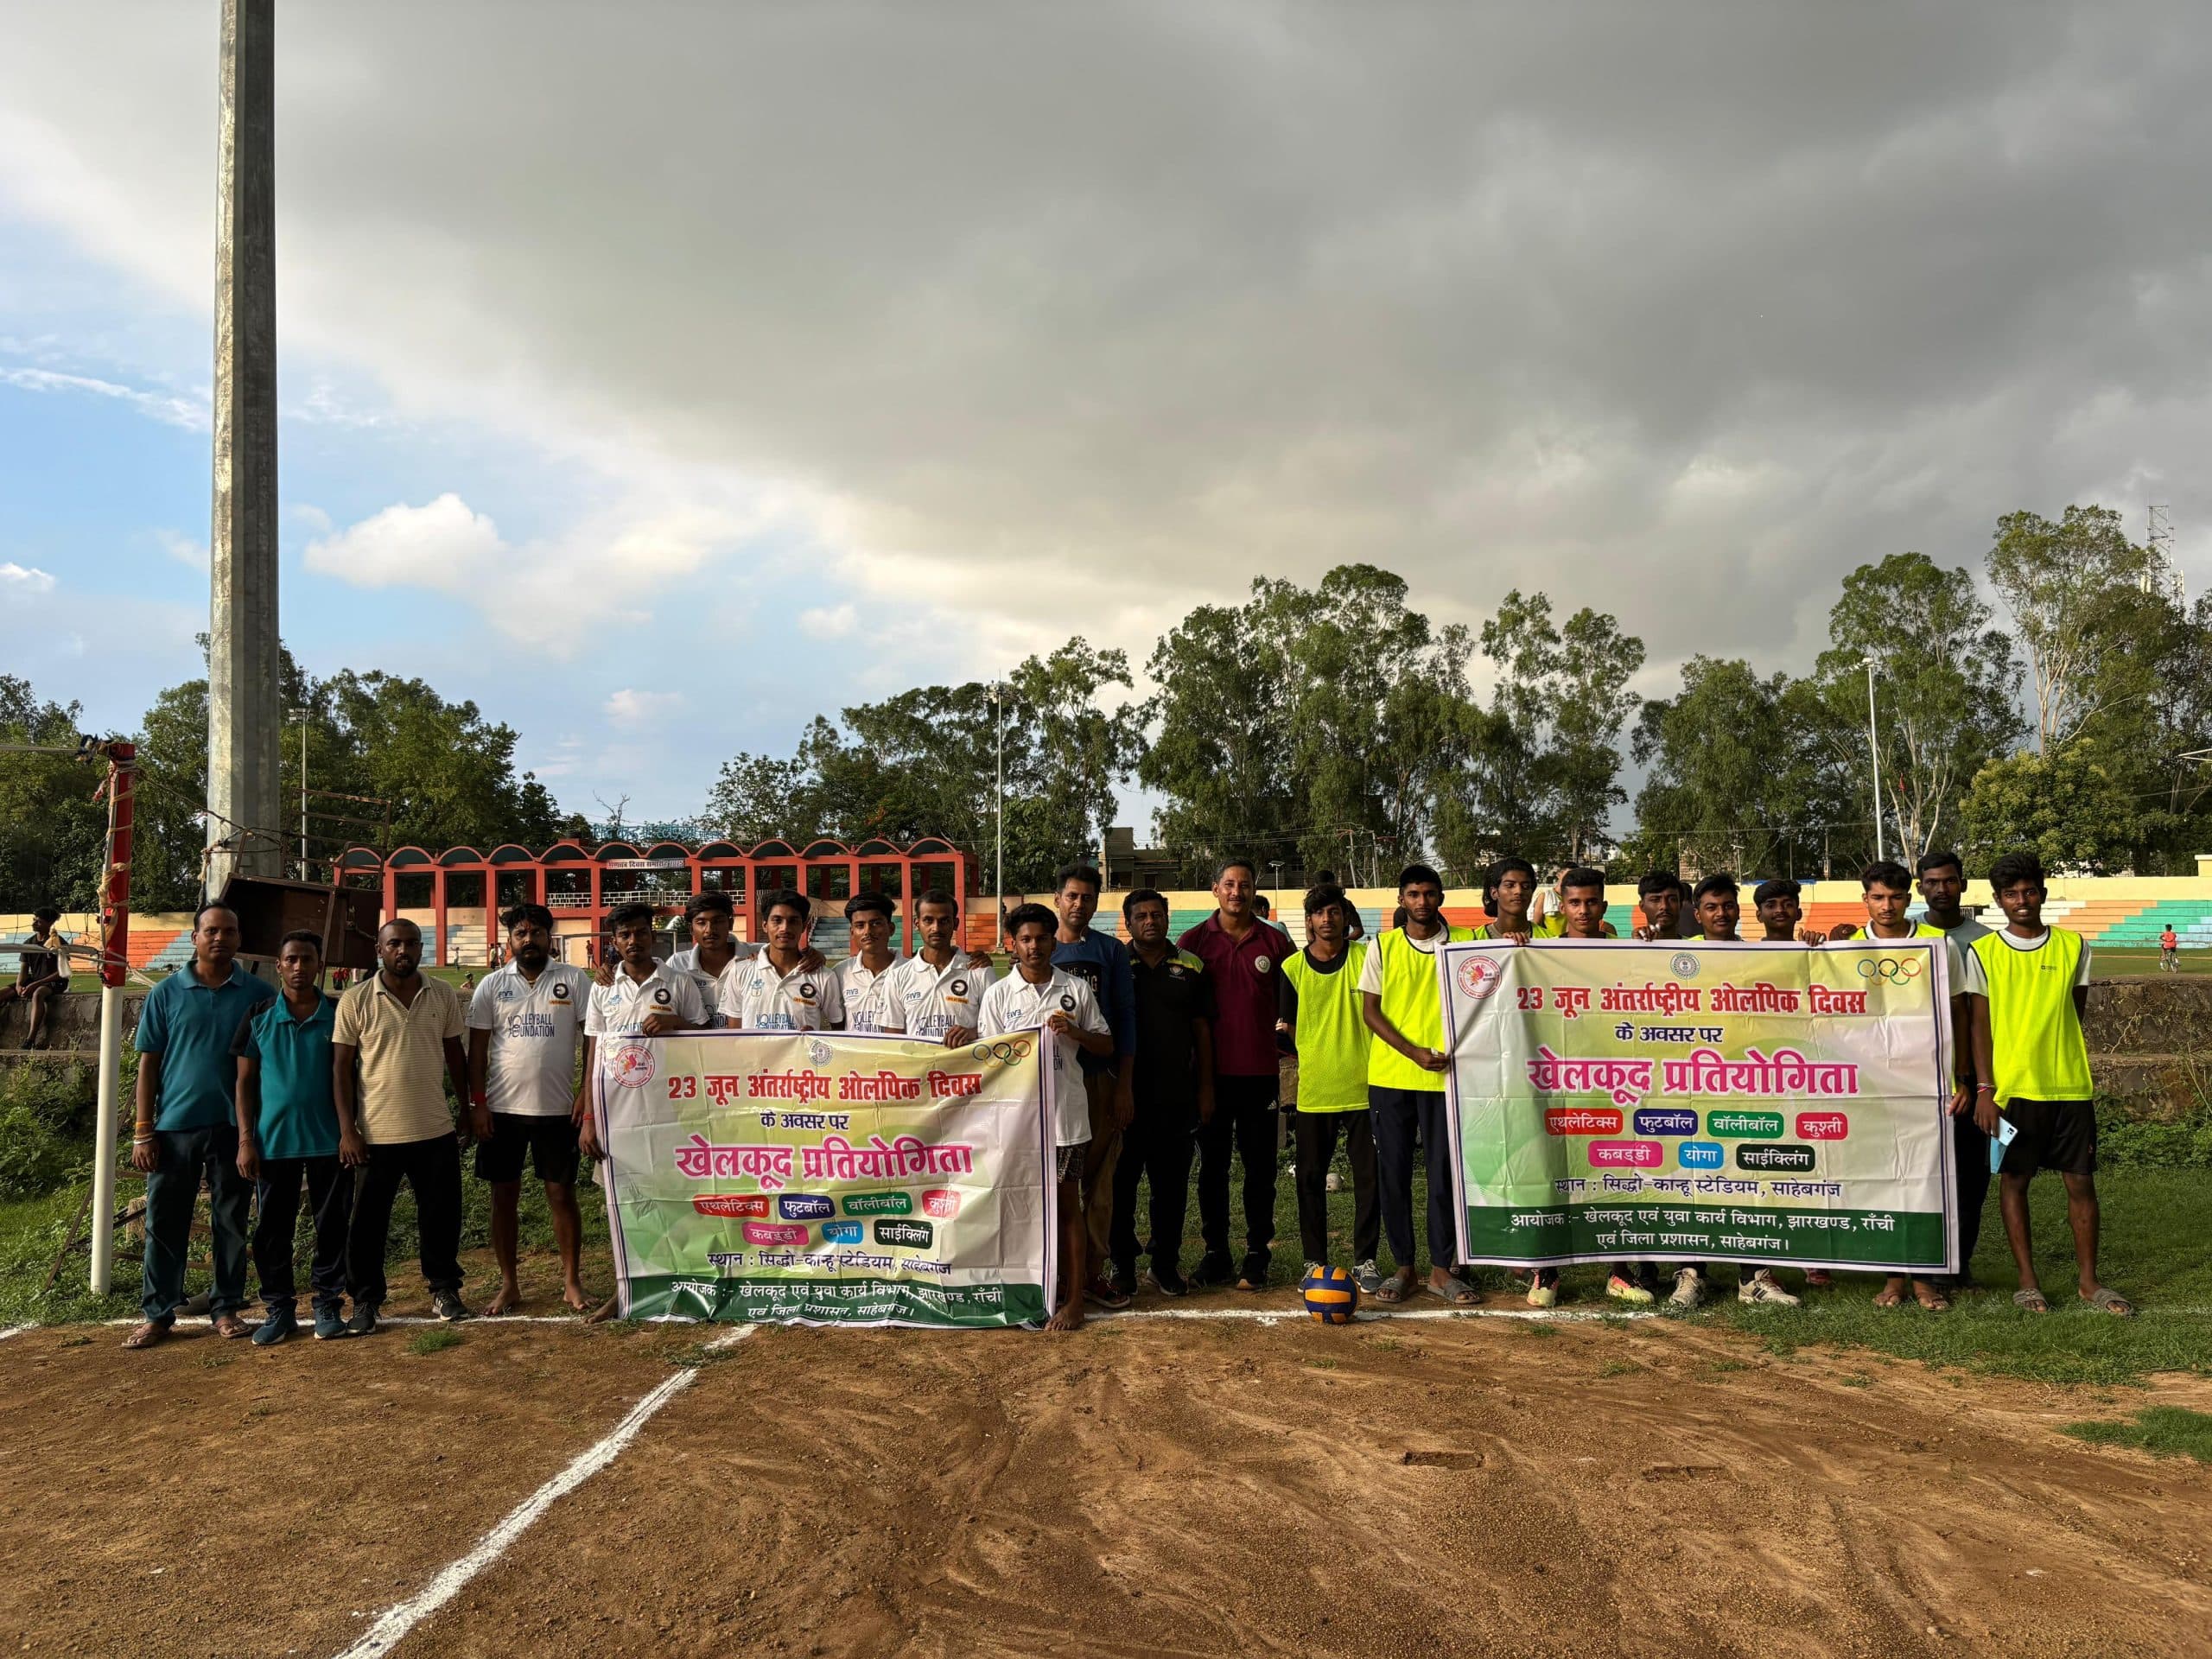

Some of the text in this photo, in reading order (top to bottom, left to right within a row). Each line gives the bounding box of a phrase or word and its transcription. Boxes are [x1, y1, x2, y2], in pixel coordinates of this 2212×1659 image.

[1516, 982, 1867, 1018] 23 जून अंतर्राष्ट्रीय ओलंपिक दिवस
[508, 1013, 552, 1028] VOLLEYBALL
[756, 1013, 795, 1027] VOLLEYBALL
[915, 1014, 957, 1030] VOLLEYBALL
[508, 1025, 555, 1038] FOUNDATION
[915, 1027, 950, 1038] FOUNDAT
[1615, 1022, 1724, 1043] के अवसर पर
[1528, 1046, 1859, 1104] खेलकूद प्रतियोगिता
[668, 1068, 982, 1106] 23 जून अंतर्राष्ट्रीय ओलंपिक दिवस
[760, 1111, 850, 1130] के अवसर पर
[1548, 1113, 1618, 1132] एथलेटिक्स
[1638, 1113, 1694, 1133] फुटबॉल
[1712, 1115, 1779, 1132] वॉलीबॉल
[1802, 1116, 1843, 1138] कुश्ती
[676, 1135, 973, 1190] खेलकूद प्रतियोगिता
[1597, 1145, 1651, 1164] कबड्डी
[1683, 1146, 1718, 1162] योगा
[1741, 1148, 1810, 1168] साईक्लिंग
[1554, 1178, 1586, 1193] स्थान
[1770, 1178, 1841, 1198] साहेबगंज
[699, 1199, 765, 1214] एथलेटिक्स
[783, 1199, 830, 1217] फुटबॉल
[847, 1195, 907, 1211] वॉलीबॉल
[1510, 1210, 1565, 1227] आयोजक
[1583, 1206, 1634, 1227] खेलकूद
[1637, 1206, 1659, 1225] एवं
[1662, 1210, 1691, 1227] युवा
[1694, 1208, 1726, 1224] कार्य
[1730, 1209, 1783, 1230] विभाग,
[1860, 1212, 1896, 1232] राँची
[750, 1227, 798, 1243] कबड्डी
[826, 1224, 858, 1238] योगा
[878, 1224, 930, 1244] साईक्लिंग
[1596, 1230, 1618, 1249] एवं
[1620, 1230, 1656, 1246] जिला
[1659, 1232, 1716, 1249] प्रशासन,
[707, 1252, 743, 1268] स्थान
[901, 1254, 952, 1275] साहेबगंज
[671, 1279, 717, 1297] आयोजक
[739, 1281, 787, 1302] खेलकूद
[790, 1282, 810, 1300] एवं
[812, 1284, 837, 1301] युवा
[839, 1281, 868, 1299] कार्य
[972, 1287, 1003, 1304] राँची
[747, 1304, 768, 1319] एवं
[771, 1303, 804, 1318] जिला
